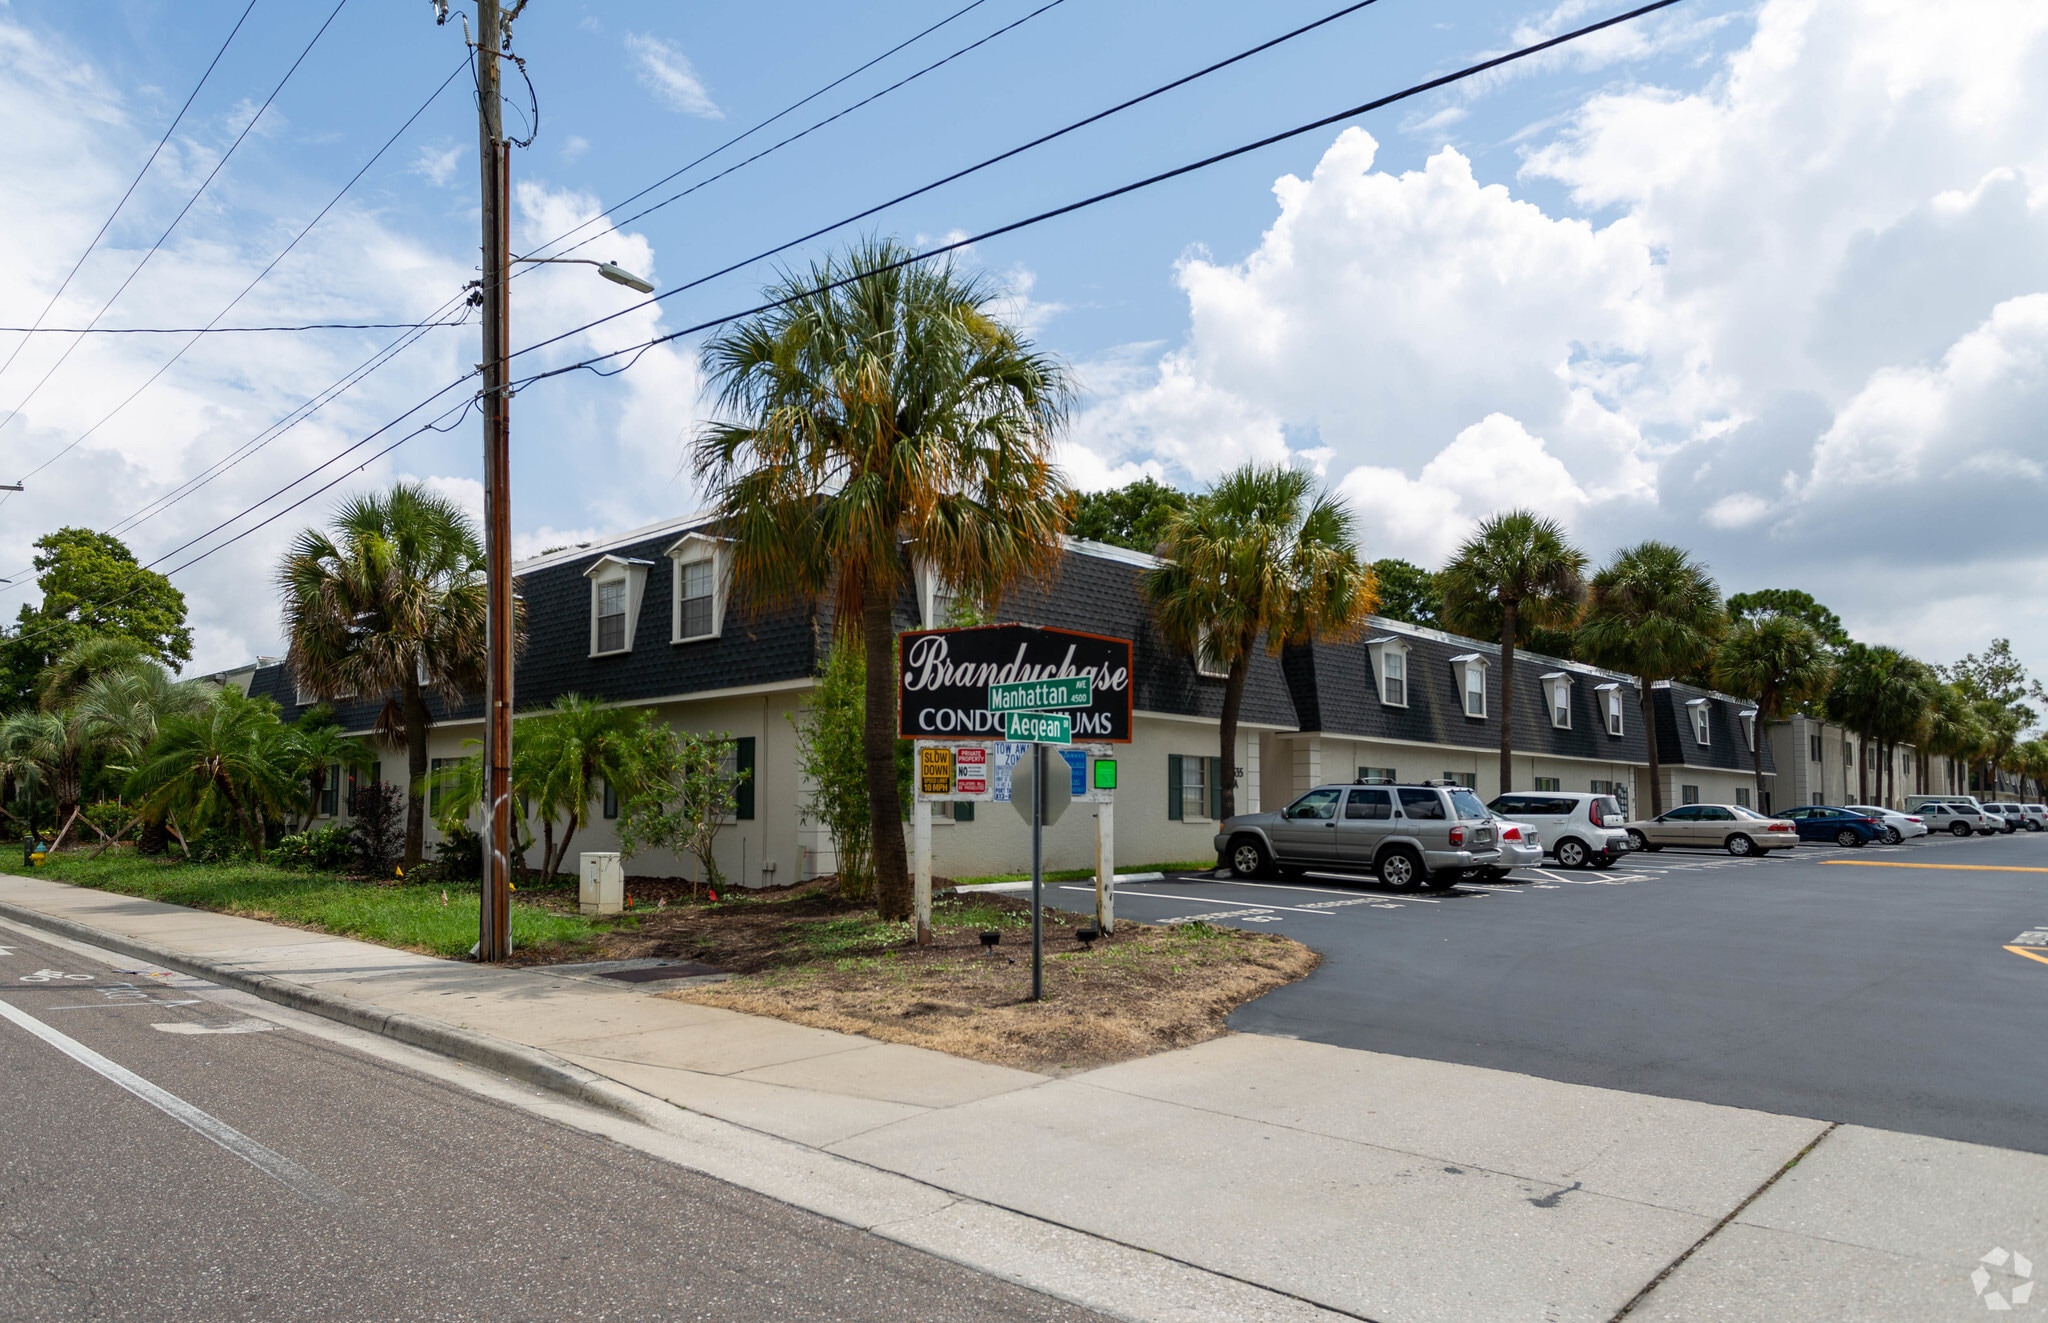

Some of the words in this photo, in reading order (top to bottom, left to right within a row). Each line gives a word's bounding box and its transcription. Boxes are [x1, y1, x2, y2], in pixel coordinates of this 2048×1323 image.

[992, 684, 1067, 709] Manhattan
[1076, 680, 1086, 688] AVE
[1071, 694, 1087, 702] 4500
[1010, 713, 1060, 741] Aegean
[996, 744, 1011, 754] TOW
[924, 752, 948, 763] SLOW
[924, 765, 948, 775] DOWN
[958, 766, 968, 776] NO
